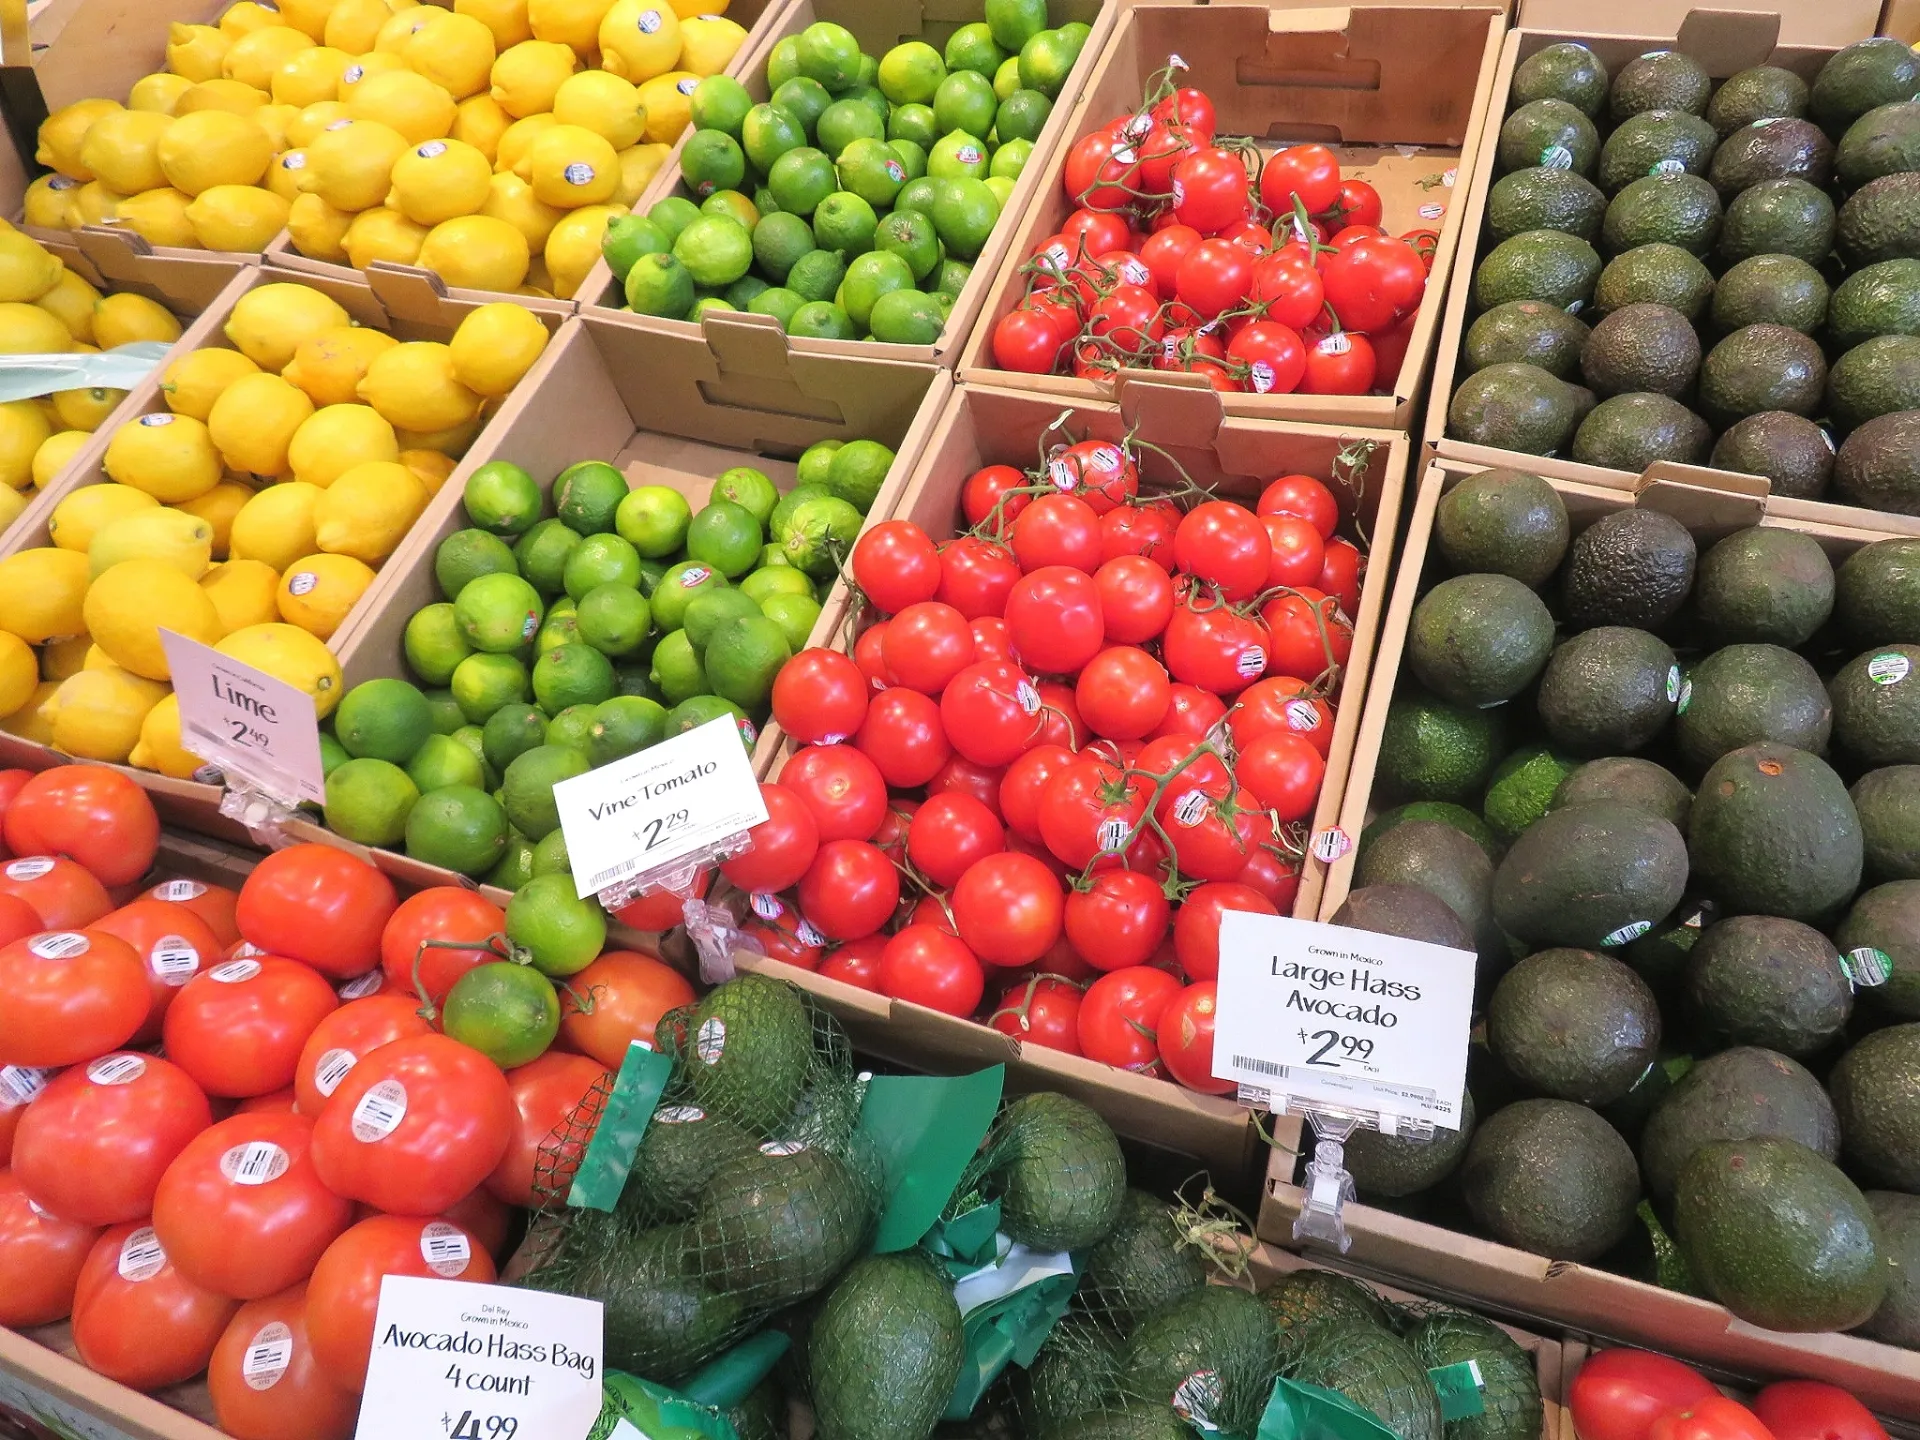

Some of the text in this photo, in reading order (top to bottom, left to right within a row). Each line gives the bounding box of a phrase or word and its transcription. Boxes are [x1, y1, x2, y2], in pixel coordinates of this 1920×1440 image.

[211, 673, 279, 724] Lime
[588, 761, 717, 821] Vine Tomato
[1308, 945, 1384, 966] Grown in Mexico
[1271, 955, 1422, 1001] Large Hass
[1286, 989, 1398, 1028] Avocado
[460, 1312, 530, 1330] Grown in Mexico
[481, 1304, 511, 1318] Del Rey
[383, 1323, 596, 1381] Avocado Hass Bag
[445, 1363, 537, 1397] 4 count
